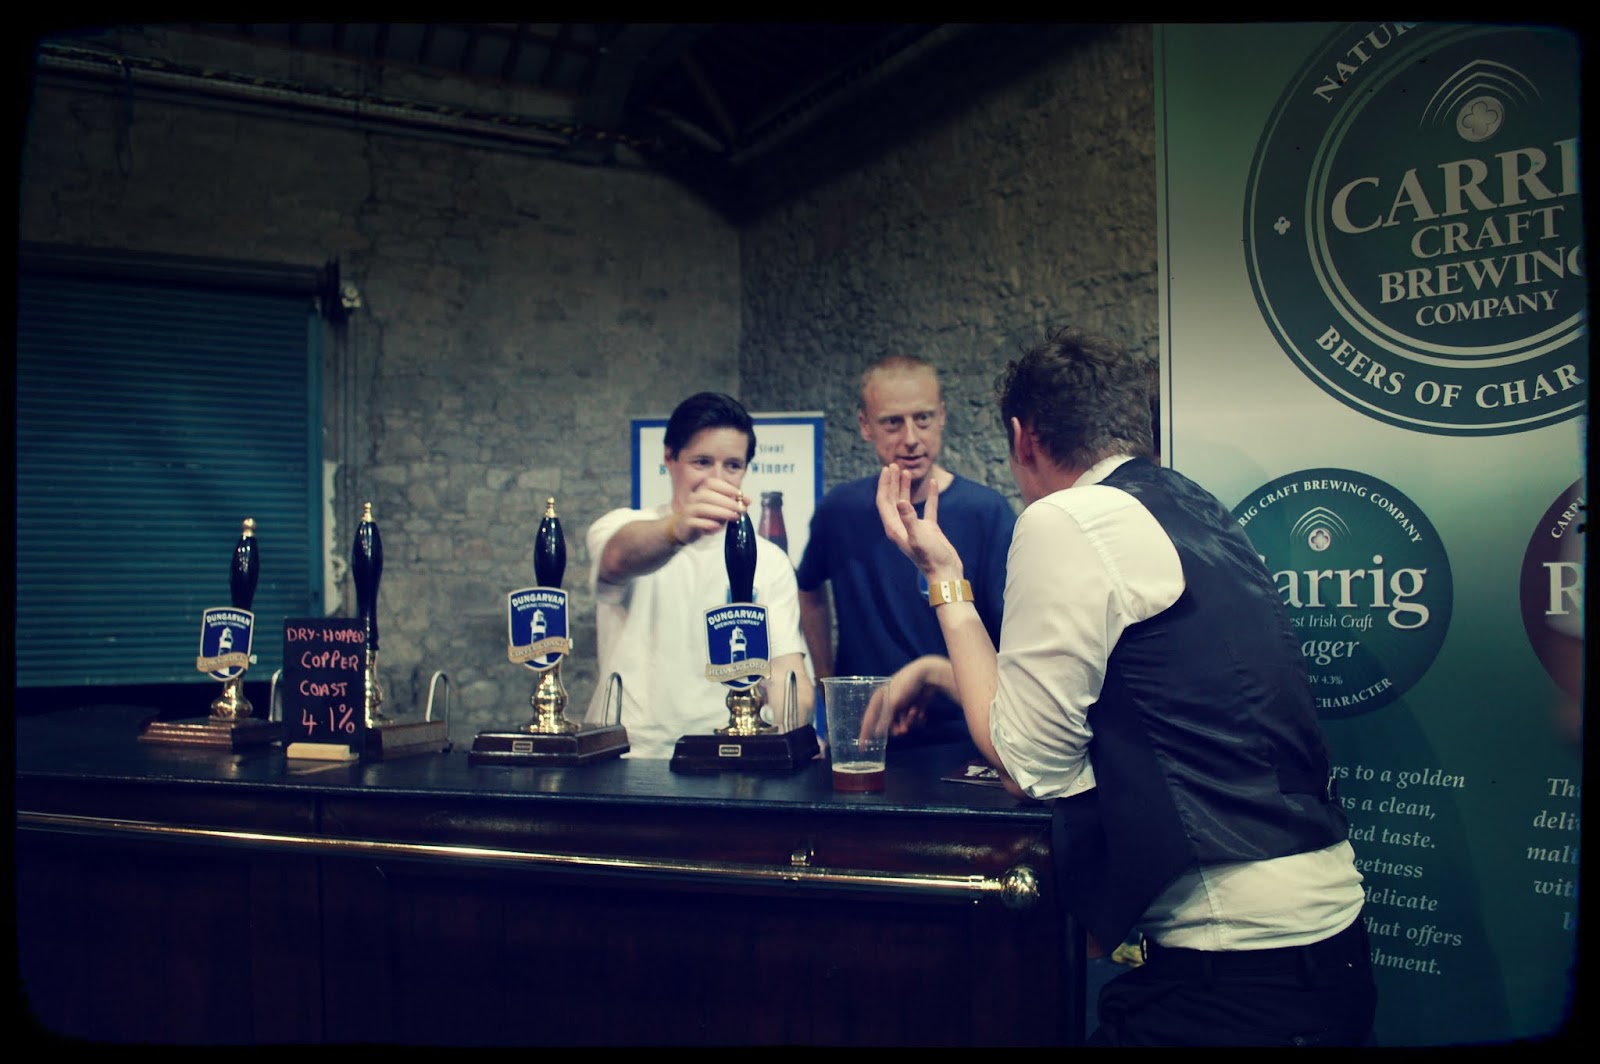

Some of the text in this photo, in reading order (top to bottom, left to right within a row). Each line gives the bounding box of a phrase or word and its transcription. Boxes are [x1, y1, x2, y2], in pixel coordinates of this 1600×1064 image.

[1411, 205, 1565, 259] CRAFT
[1416, 289, 1559, 327] COMPANY
[1315, 325, 1585, 409] BEERS OF CHAR
[752, 462, 795, 474] Winner
[1259, 483, 1299, 509] CRAFT
[1303, 480, 1368, 498] BREWING
[1370, 493, 1423, 543] COMPANY
[511, 593, 565, 607] DUNGARVAN
[1258, 554, 1430, 630] arrig
[206, 613, 251, 626] DUNGARVAN
[707, 609, 765, 625] DUNGARVAN
[714, 619, 736, 630] BREWING
[1308, 614, 1337, 628] Irish
[1340, 614, 1373, 631] Craft
[287, 628, 365, 643] DRY-HOPPED
[301, 650, 360, 672] COPPER
[300, 680, 348, 697] COAST
[1321, 675, 1343, 685] 4.3%
[1315, 677, 1393, 708] CHARACTER
[1355, 765, 1375, 780] to
[1380, 769, 1392, 783] a
[1396, 768, 1466, 789] golden
[1361, 799, 1372, 811] a
[1378, 796, 1437, 820] clean,
[1381, 827, 1436, 849] taste.
[1363, 886, 1439, 912] delicate
[1406, 924, 1463, 947] offers
